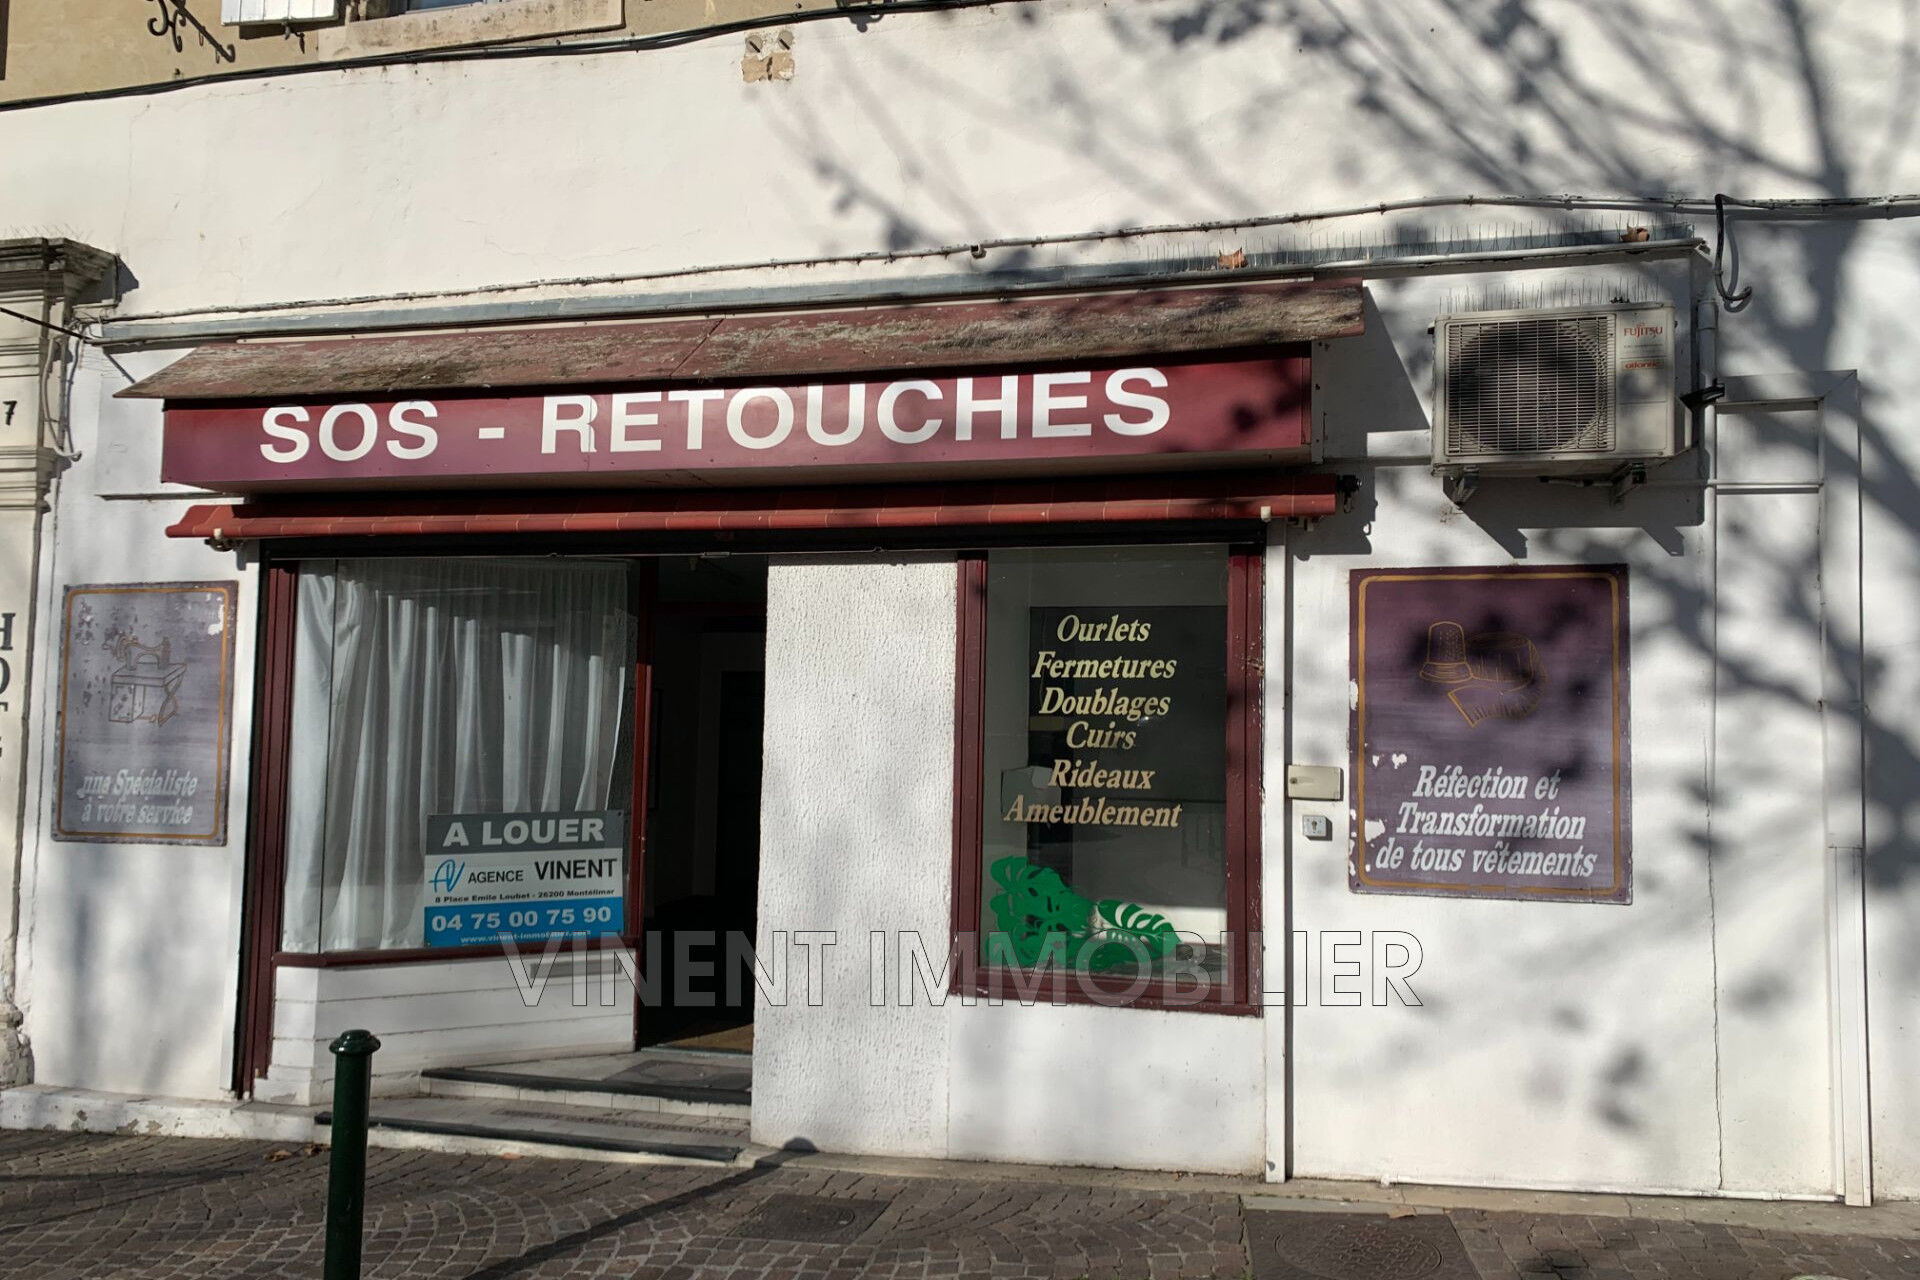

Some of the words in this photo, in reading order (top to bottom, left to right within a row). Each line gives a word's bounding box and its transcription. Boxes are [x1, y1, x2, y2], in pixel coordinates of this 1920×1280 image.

[1623, 325, 1663, 338] FUJITSU
[260, 400, 438, 463] SOS
[478, 427, 505, 439] -
[541, 367, 1170, 454] RETOUCHES
[1057, 614, 1151, 642] Ourlets
[1032, 651, 1177, 679] Fermetures
[1039, 687, 1171, 722] Doublages
[1066, 721, 1137, 750] Cuirs
[113, 769, 198, 802] Spécialiste
[1048, 759, 1155, 790] Rideaux
[1412, 764, 1528, 799] Réfection
[1534, 769, 1561, 799] et
[97, 799, 137, 823] votre
[136, 798, 194, 824] service
[1003, 794, 1183, 828] Ameublement
[1396, 802, 1586, 839] Transformation
[442, 822, 470, 847] A
[482, 818, 604, 846] LOUER
[467, 870, 524, 884] AGENCE
[534, 858, 617, 881] VINENT
[1375, 838, 1404, 869] de
[1410, 840, 1464, 872] tous
[1472, 841, 1598, 877] vêtements
[431, 914, 463, 932] 04
[471, 912, 501, 929] 75
[508, 911, 538, 927] 00
[546, 908, 575, 925] 75
[582, 906, 612, 923] 90
